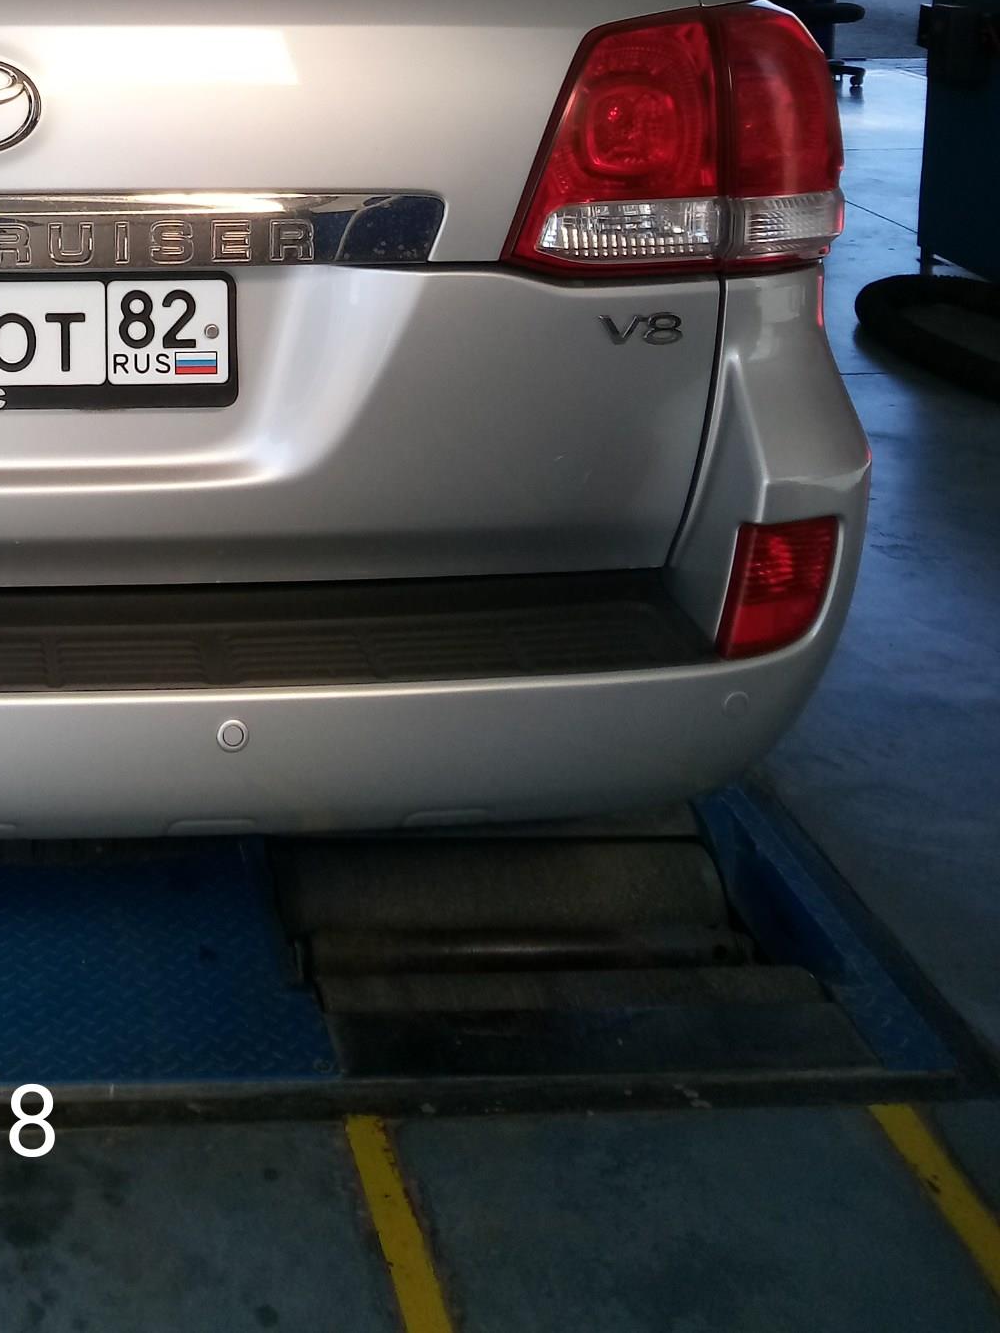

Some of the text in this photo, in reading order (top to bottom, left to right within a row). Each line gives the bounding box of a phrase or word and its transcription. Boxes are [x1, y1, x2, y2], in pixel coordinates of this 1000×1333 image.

[117, 289, 198, 350] 82
[598, 312, 684, 346] V8
[112, 352, 172, 375] RUS
